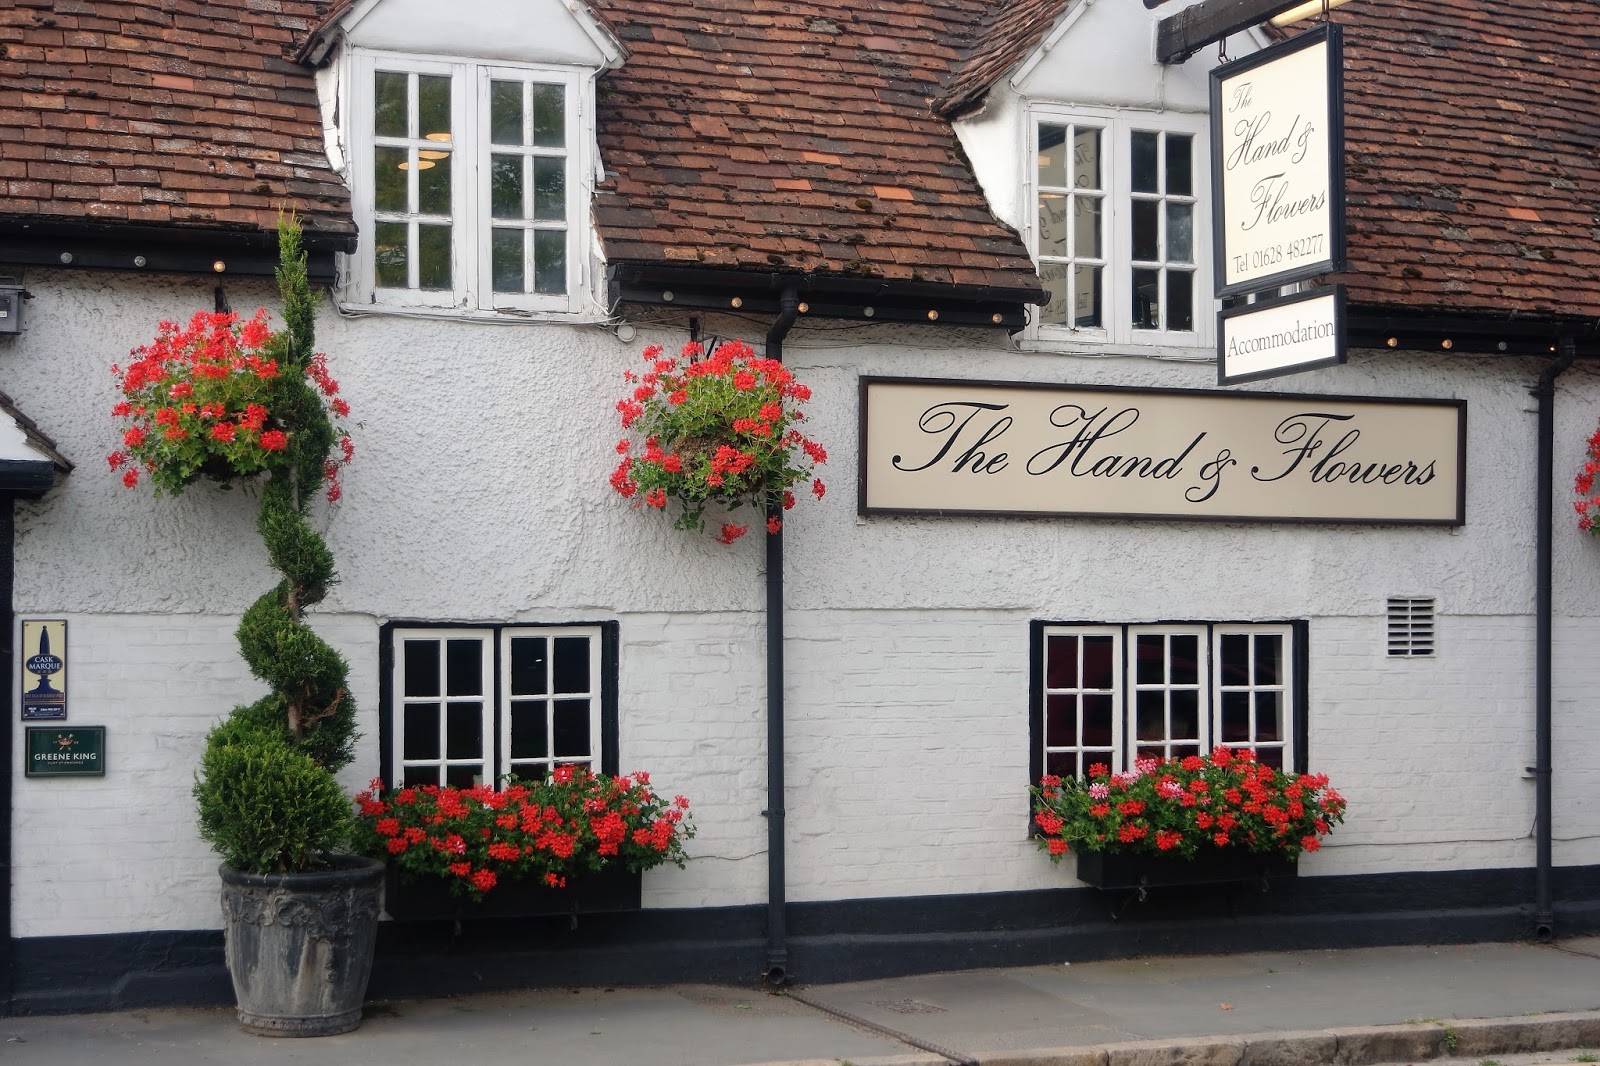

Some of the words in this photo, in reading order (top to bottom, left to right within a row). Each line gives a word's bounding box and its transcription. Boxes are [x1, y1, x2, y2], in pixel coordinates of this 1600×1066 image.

[1228, 81, 1253, 113] The
[1226, 111, 1301, 171] Hand
[1291, 121, 1315, 165] &
[1241, 171, 1326, 231] Flowers
[1233, 255, 1249, 274] Tel
[1252, 244, 1283, 269] 01628
[1286, 233, 1324, 262] 482277
[1227, 319, 1335, 358] Accommodation
[891, 401, 1014, 474] The
[1026, 404, 1208, 480] Hand
[1184, 448, 1237, 503] &
[1251, 413, 1438, 487] Flowers
